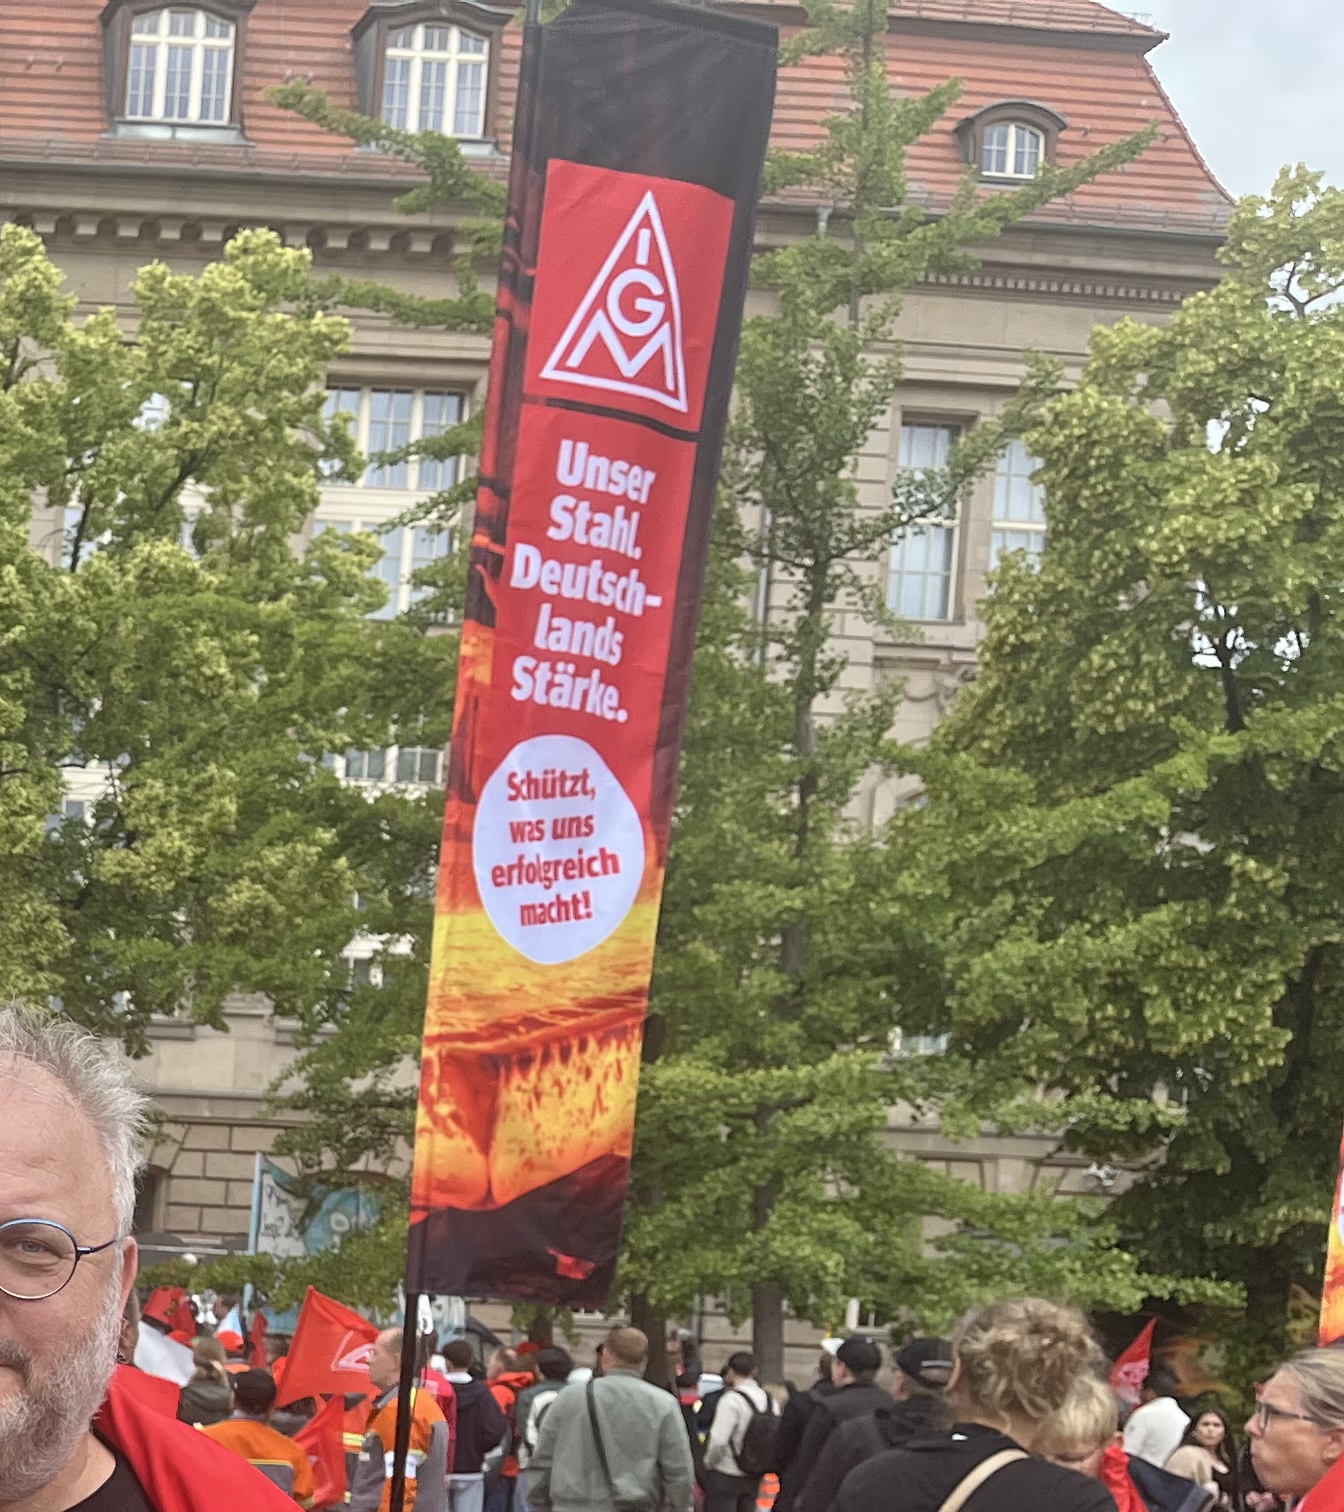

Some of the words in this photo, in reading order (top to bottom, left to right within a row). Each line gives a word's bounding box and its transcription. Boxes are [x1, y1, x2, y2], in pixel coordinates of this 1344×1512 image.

[556, 438, 657, 504] Unser
[546, 494, 643, 560] Stahl.
[510, 543, 662, 616] Deutsch-
[534, 602, 624, 665] lands
[511, 655, 629, 723] Stärke.
[507, 768, 597, 802] Schützt,
[509, 819, 546, 843] was
[552, 815, 594, 840] uns
[491, 846, 621, 890] erfolgreich
[520, 891, 593, 926] macht!
